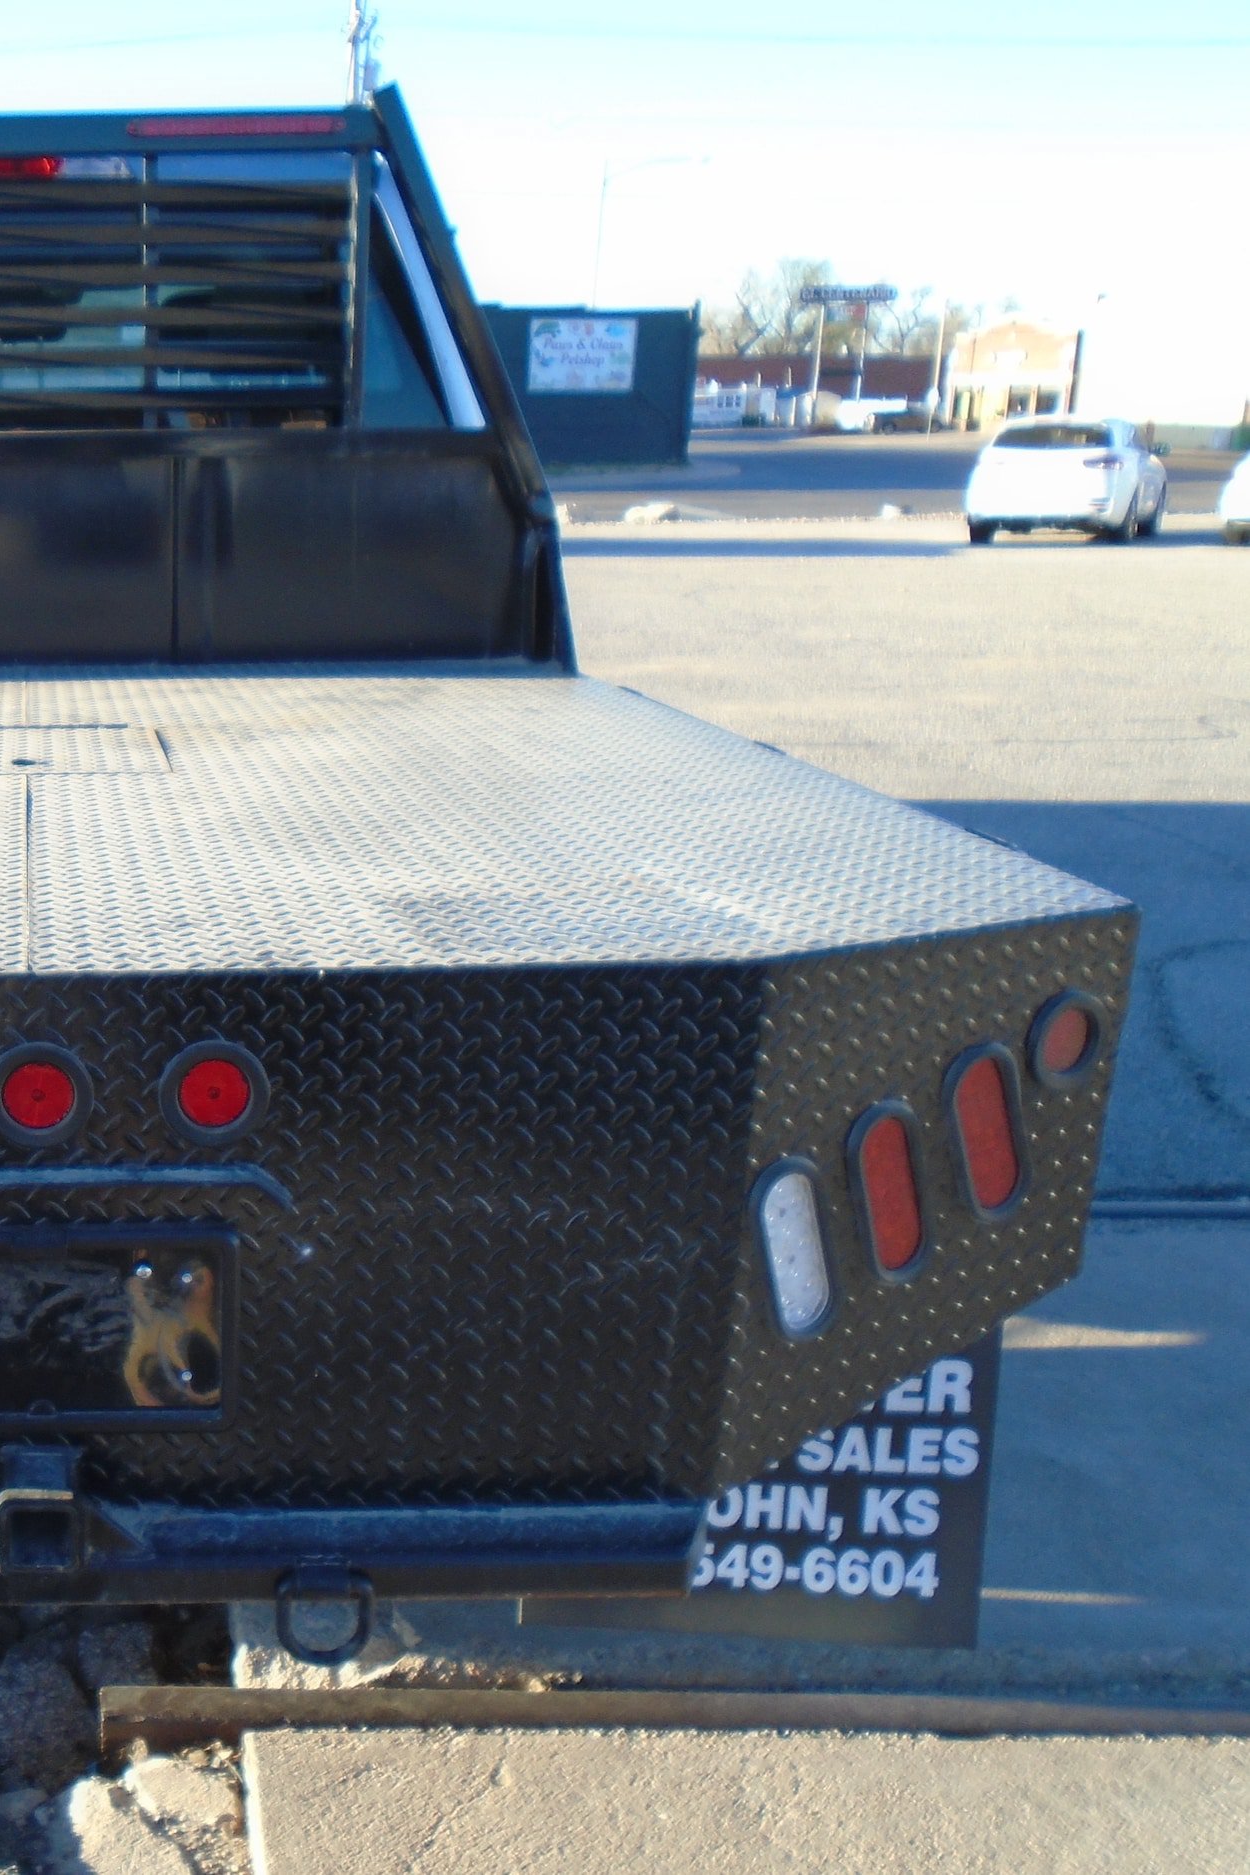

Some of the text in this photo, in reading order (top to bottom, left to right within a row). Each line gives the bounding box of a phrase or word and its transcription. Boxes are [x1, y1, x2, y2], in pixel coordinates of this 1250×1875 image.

[576, 338, 586, 350] &
[798, 1426, 979, 1476] SALES
[863, 1488, 940, 1536] KS
